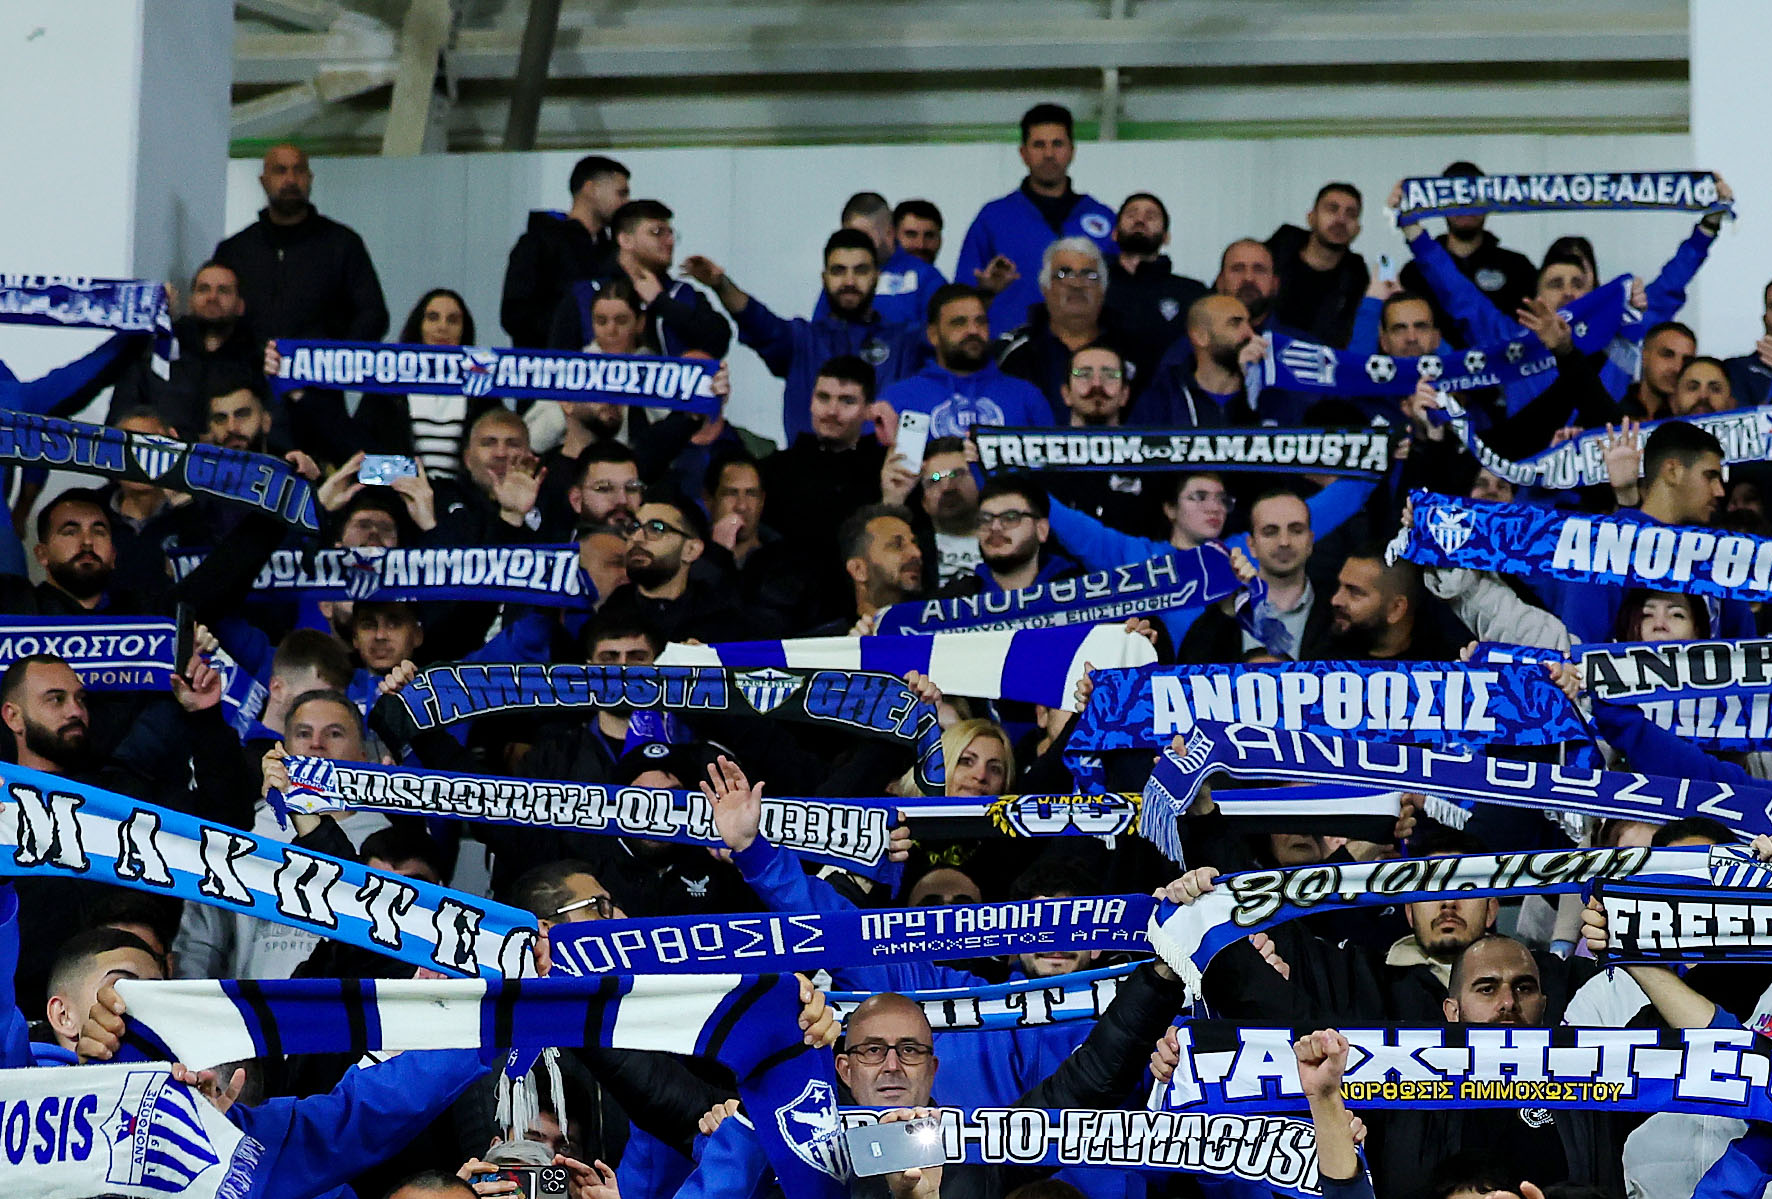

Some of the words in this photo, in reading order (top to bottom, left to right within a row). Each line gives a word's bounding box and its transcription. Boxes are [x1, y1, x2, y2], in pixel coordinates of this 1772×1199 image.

[1614, 173, 1719, 207] ΑΔΕΛΦ
[291, 348, 463, 386] ΑΝΟΡΘΩΣΙΣ
[497, 354, 703, 401] ΑΜΜΟΧΩΣΤΟΥ
[978, 432, 1143, 471] FREEDOM
[1171, 433, 1389, 473] FAMAGUSTA
[399, 664, 728, 730] FAMAGUSTA
[1151, 671, 1500, 736] ΑΝΟΡΘΩΣΙΣ
[1070, 927, 1150, 944] ΑΓΑΠ
[1459, 1080, 1624, 1103] ΑΜΜΟΧΩΣΤΟΥ
[0, 1094, 98, 1165] OSIS
[134, 1089, 157, 1166] ΑΝΟΡΘΩΣΙΣ
